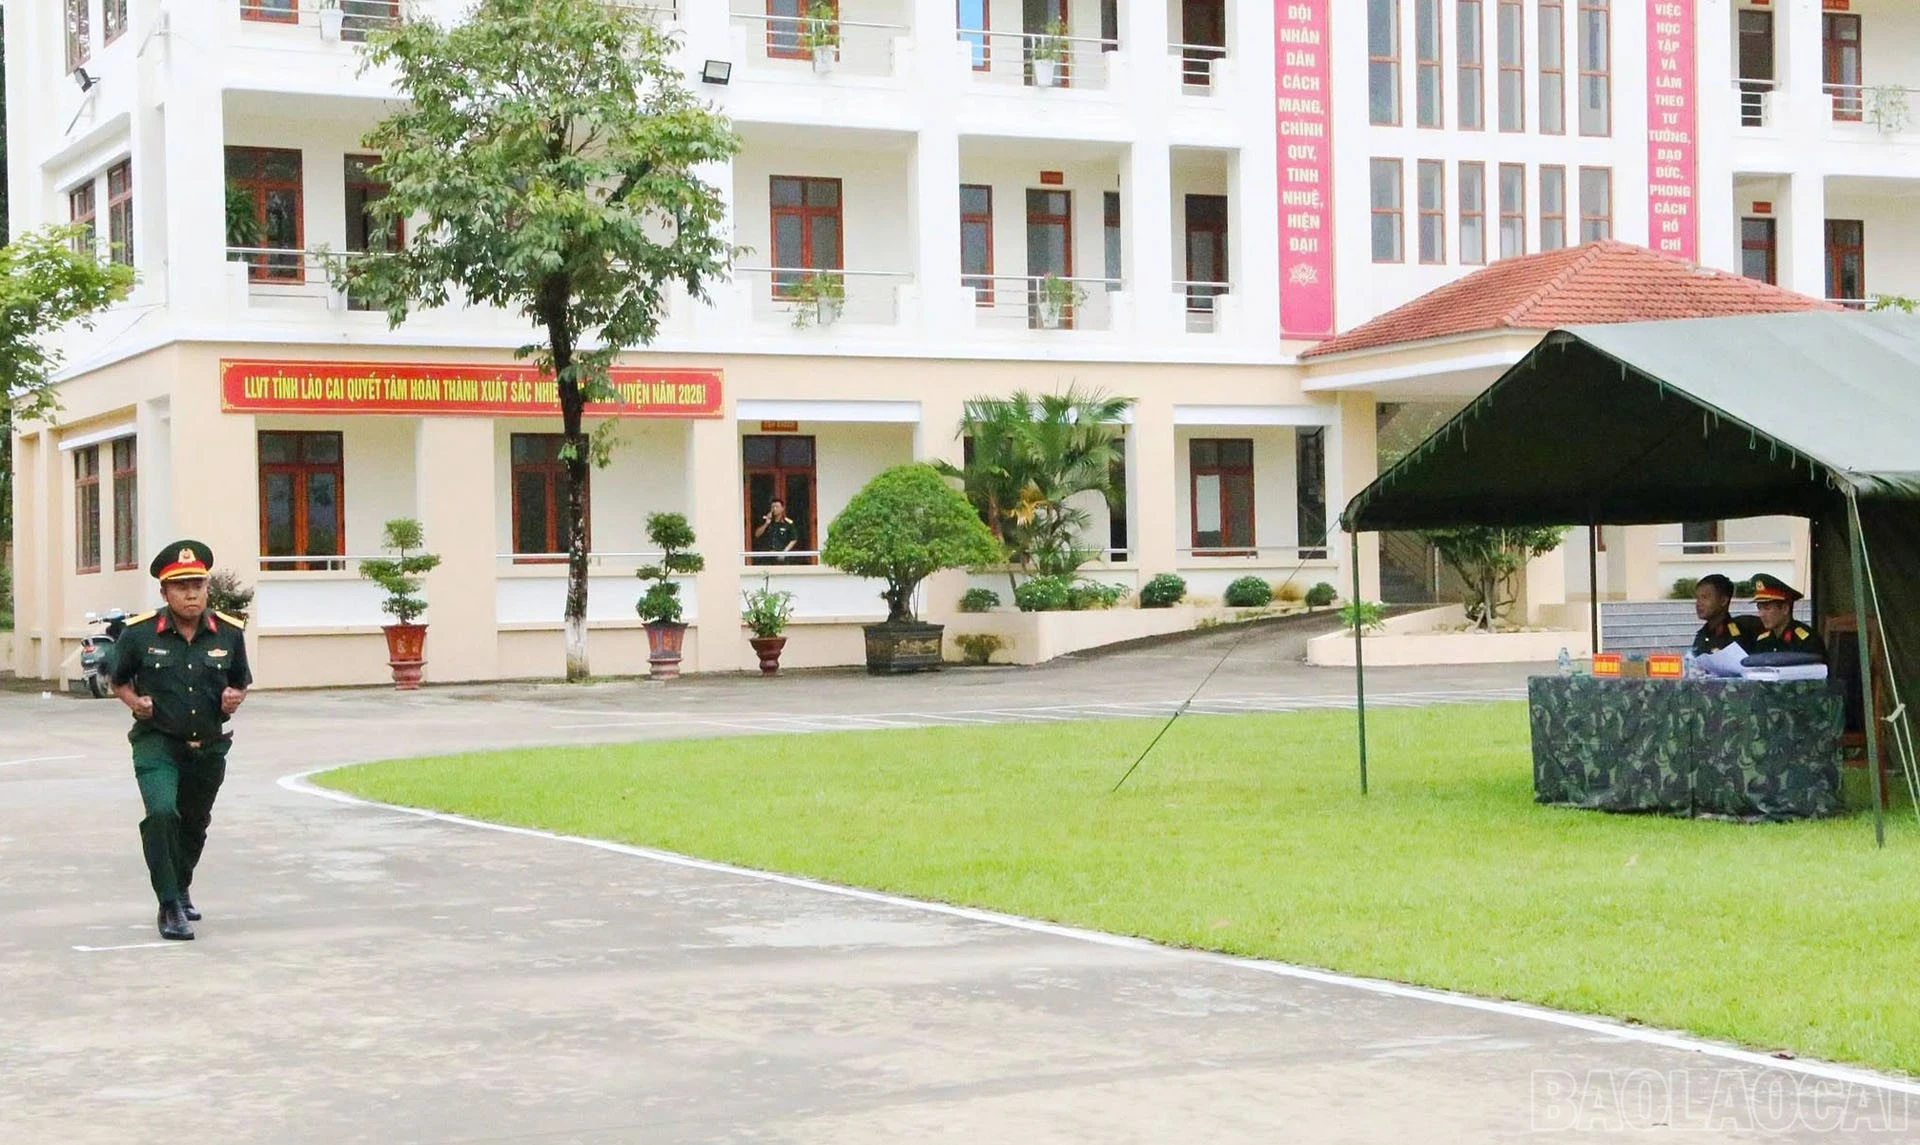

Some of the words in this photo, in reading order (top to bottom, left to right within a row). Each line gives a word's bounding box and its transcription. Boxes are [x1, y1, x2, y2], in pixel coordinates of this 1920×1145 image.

[1287, 4, 1312, 23] ĐỘI
[1655, 3, 1682, 18] VIỆC
[1280, 27, 1320, 45] NHÂN
[1656, 21, 1681, 36] HỌC
[1657, 39, 1680, 55] TẬP
[1286, 49, 1315, 67] DÂN
[1282, 73, 1320, 91] CÁCH
[1279, 97, 1324, 116] MẠNG,
[1655, 94, 1684, 107] THEO
[1280, 118, 1323, 137] CHÍNH
[1287, 144, 1317, 162] QUY,
[1287, 167, 1319, 183] TINH
[1282, 189, 1324, 210] NHUỆ,
[1650, 184, 1691, 197] PHONG
[1655, 200, 1687, 215] CÁCH
[1287, 211, 1320, 232] HIỆN
[1289, 237, 1318, 254] ĐẠI!
[1660, 238, 1681, 251] CHÍ
[244, 376, 270, 399] LLVT
[272, 370, 299, 399] TỈNH
[301, 373, 323, 400] LÀO
[325, 377, 345, 400] CAI
[347, 371, 382, 402] QUYẾT
[384, 374, 408, 401] TÂM
[410, 375, 440, 401] HOÀN
[443, 376, 478, 402] THÀNH
[481, 374, 508, 402] XUẤT
[510, 373, 532, 403] SẮC
[535, 378, 559, 408] NHIỆ
[652, 380, 676, 404] NĂM
